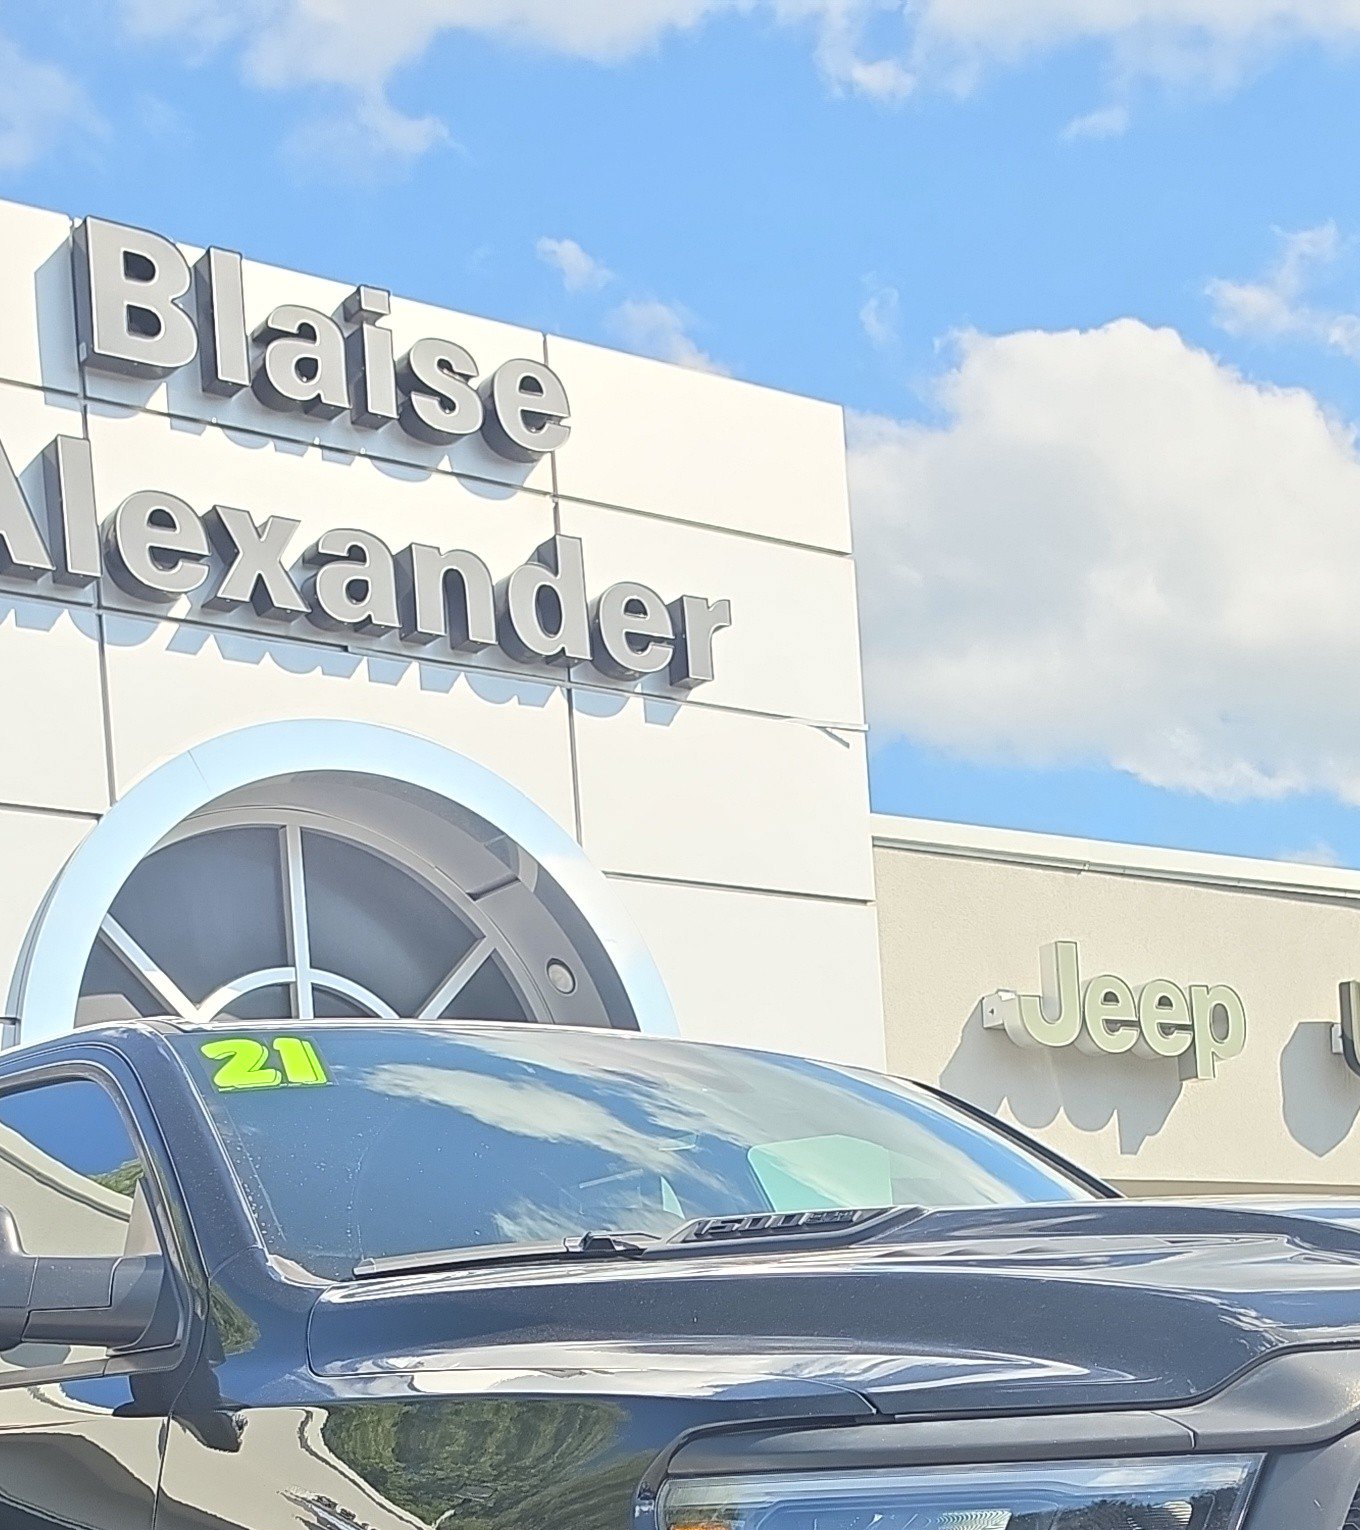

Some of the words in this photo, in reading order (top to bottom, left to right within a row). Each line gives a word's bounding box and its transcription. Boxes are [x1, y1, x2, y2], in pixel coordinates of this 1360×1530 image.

[77, 214, 572, 463] Blaise
[1014, 940, 1247, 1081] Jeep
[200, 1036, 330, 1092] 21
[693, 1211, 810, 1236] 1500
